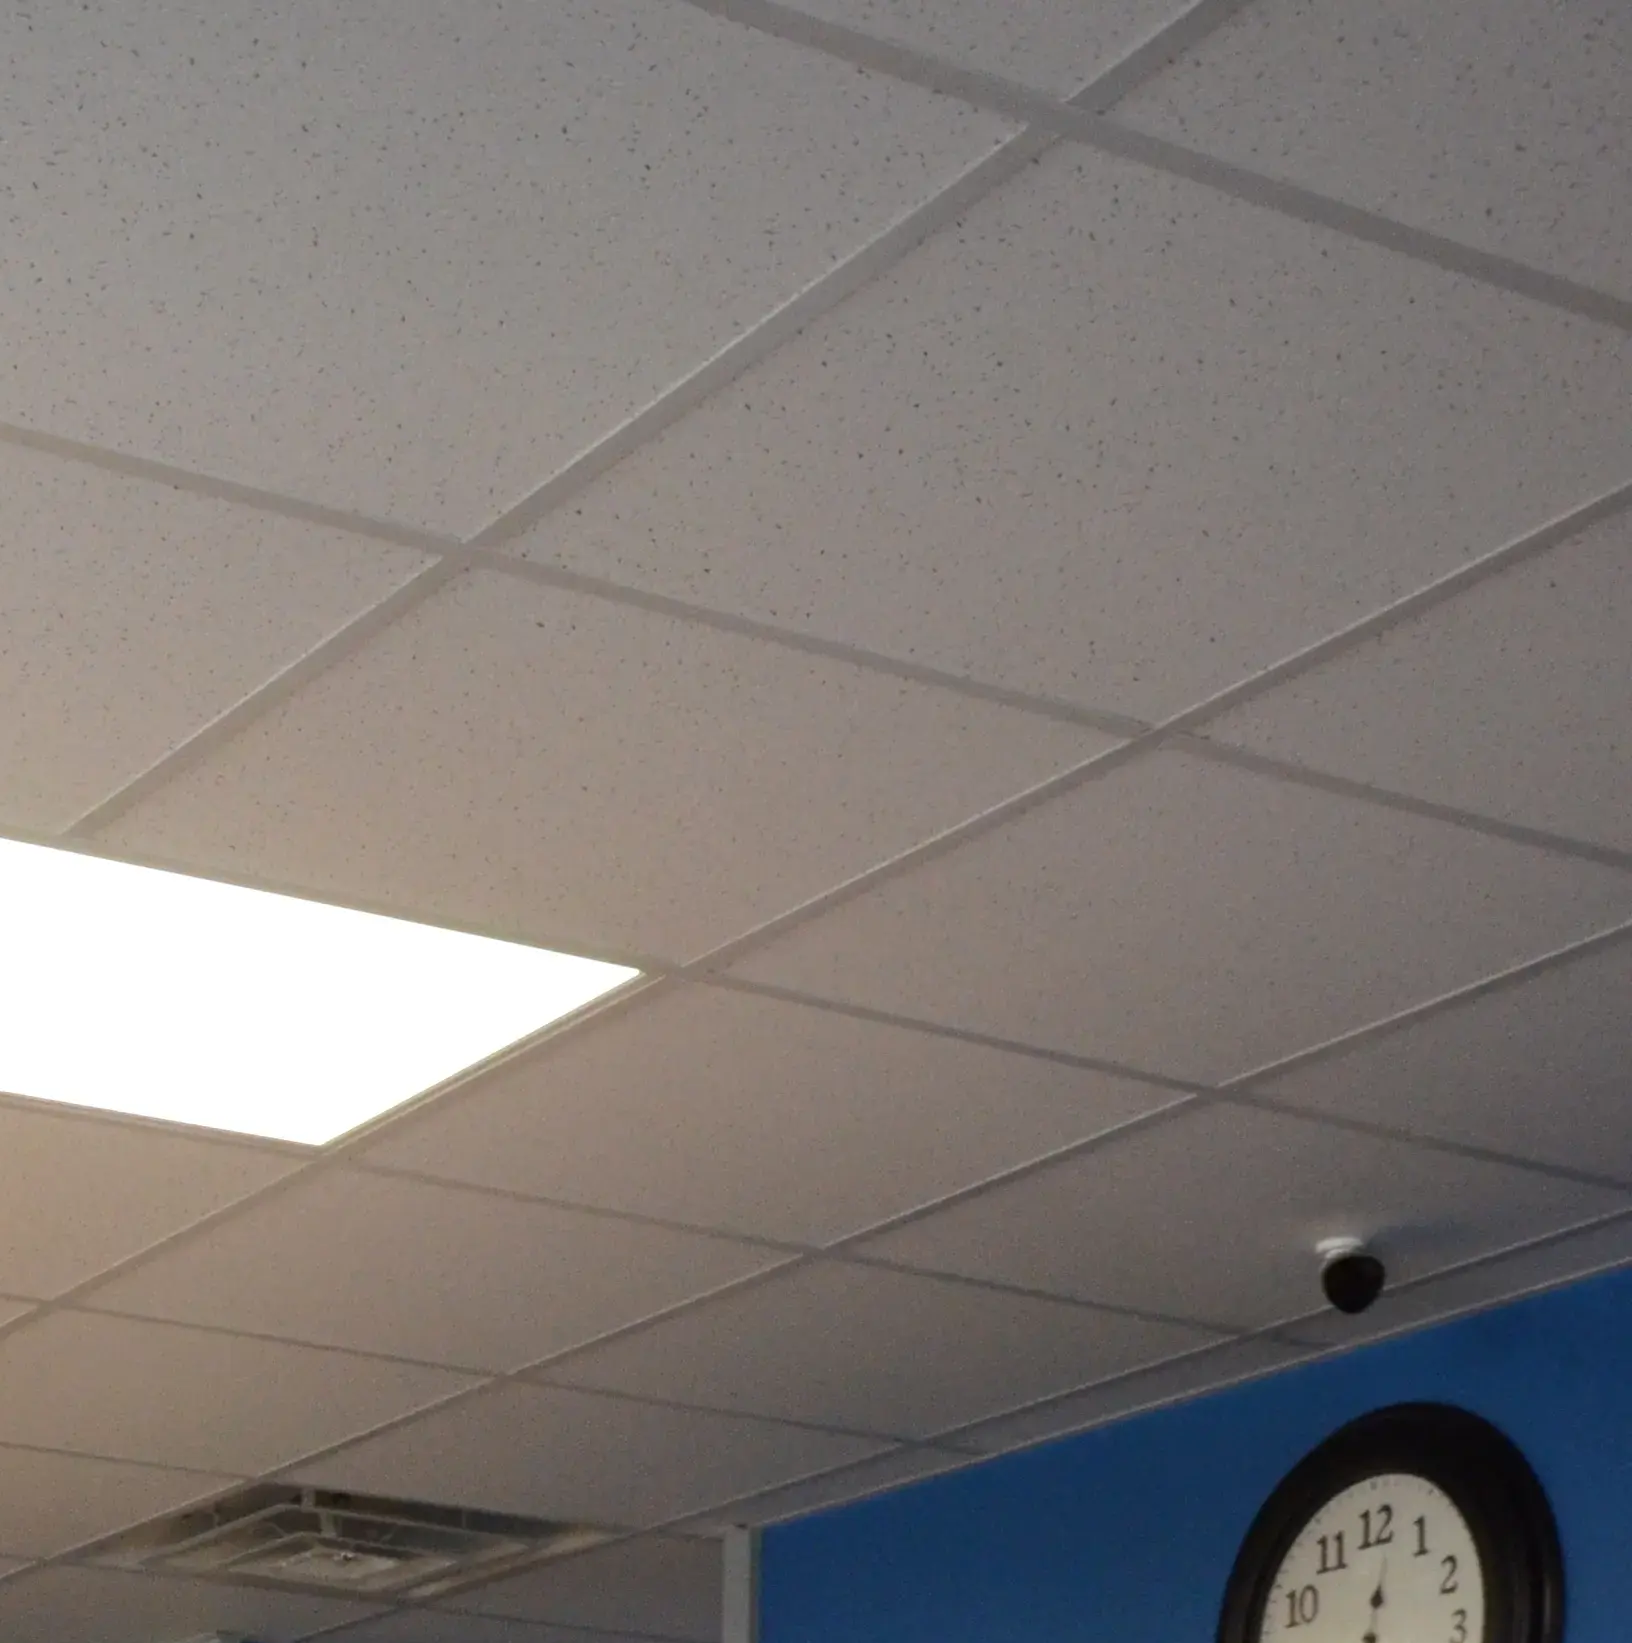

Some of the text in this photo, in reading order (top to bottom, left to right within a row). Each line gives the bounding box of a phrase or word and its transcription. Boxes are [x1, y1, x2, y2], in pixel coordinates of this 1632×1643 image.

[1357, 1504, 1394, 1551] 12
[1414, 1515, 1430, 1557] 1
[1316, 1531, 1348, 1575] 11
[1440, 1555, 1457, 1595] 2
[1284, 1585, 1319, 1628] 10
